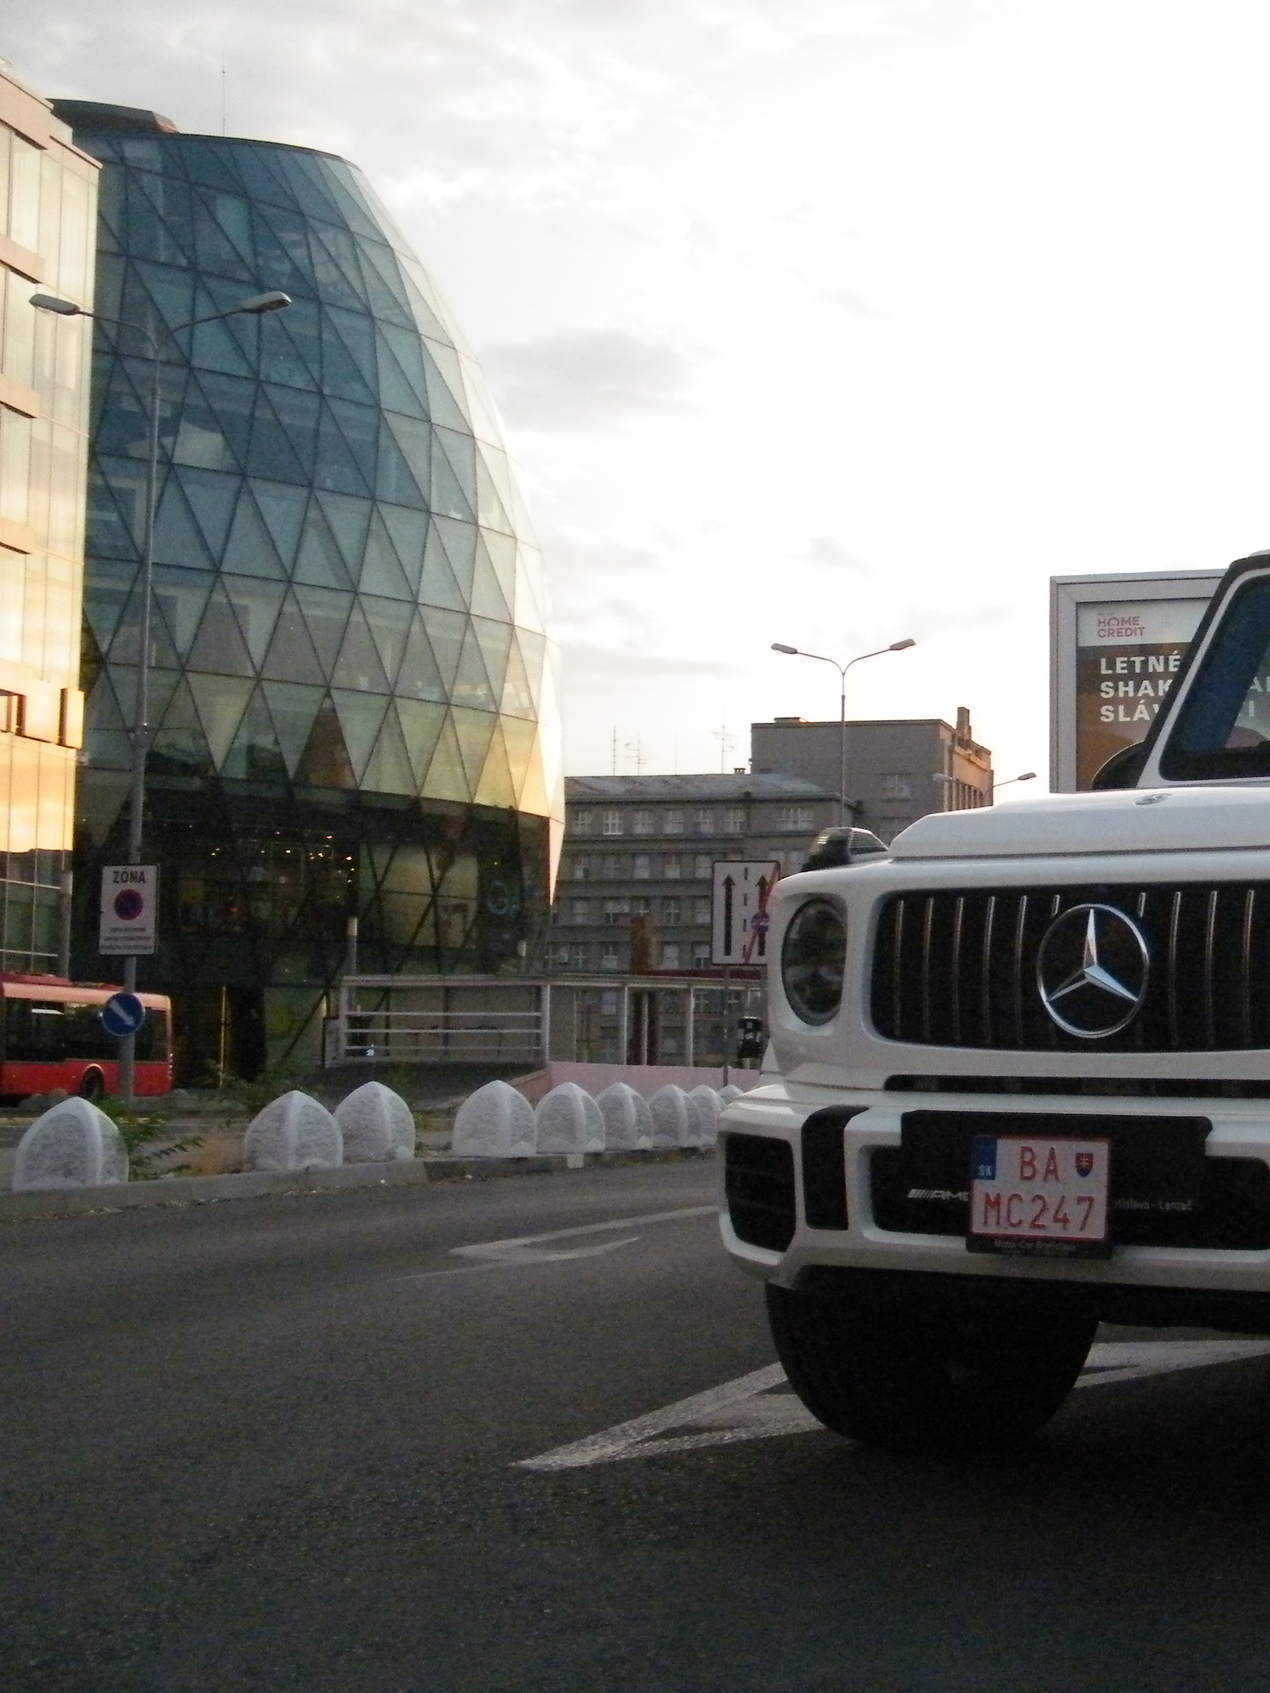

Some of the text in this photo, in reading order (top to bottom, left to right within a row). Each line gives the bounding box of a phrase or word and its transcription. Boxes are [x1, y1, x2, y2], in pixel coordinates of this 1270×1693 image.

[1097, 615, 1140, 627] HOME
[1097, 627, 1145, 638] CREDIT
[1100, 650, 1180, 674] LETNÉ
[113, 867, 146, 884] ZÓNA
[978, 1164, 992, 1177] SK
[1019, 1146, 1060, 1181] BA
[983, 1192, 1095, 1231] MC247
